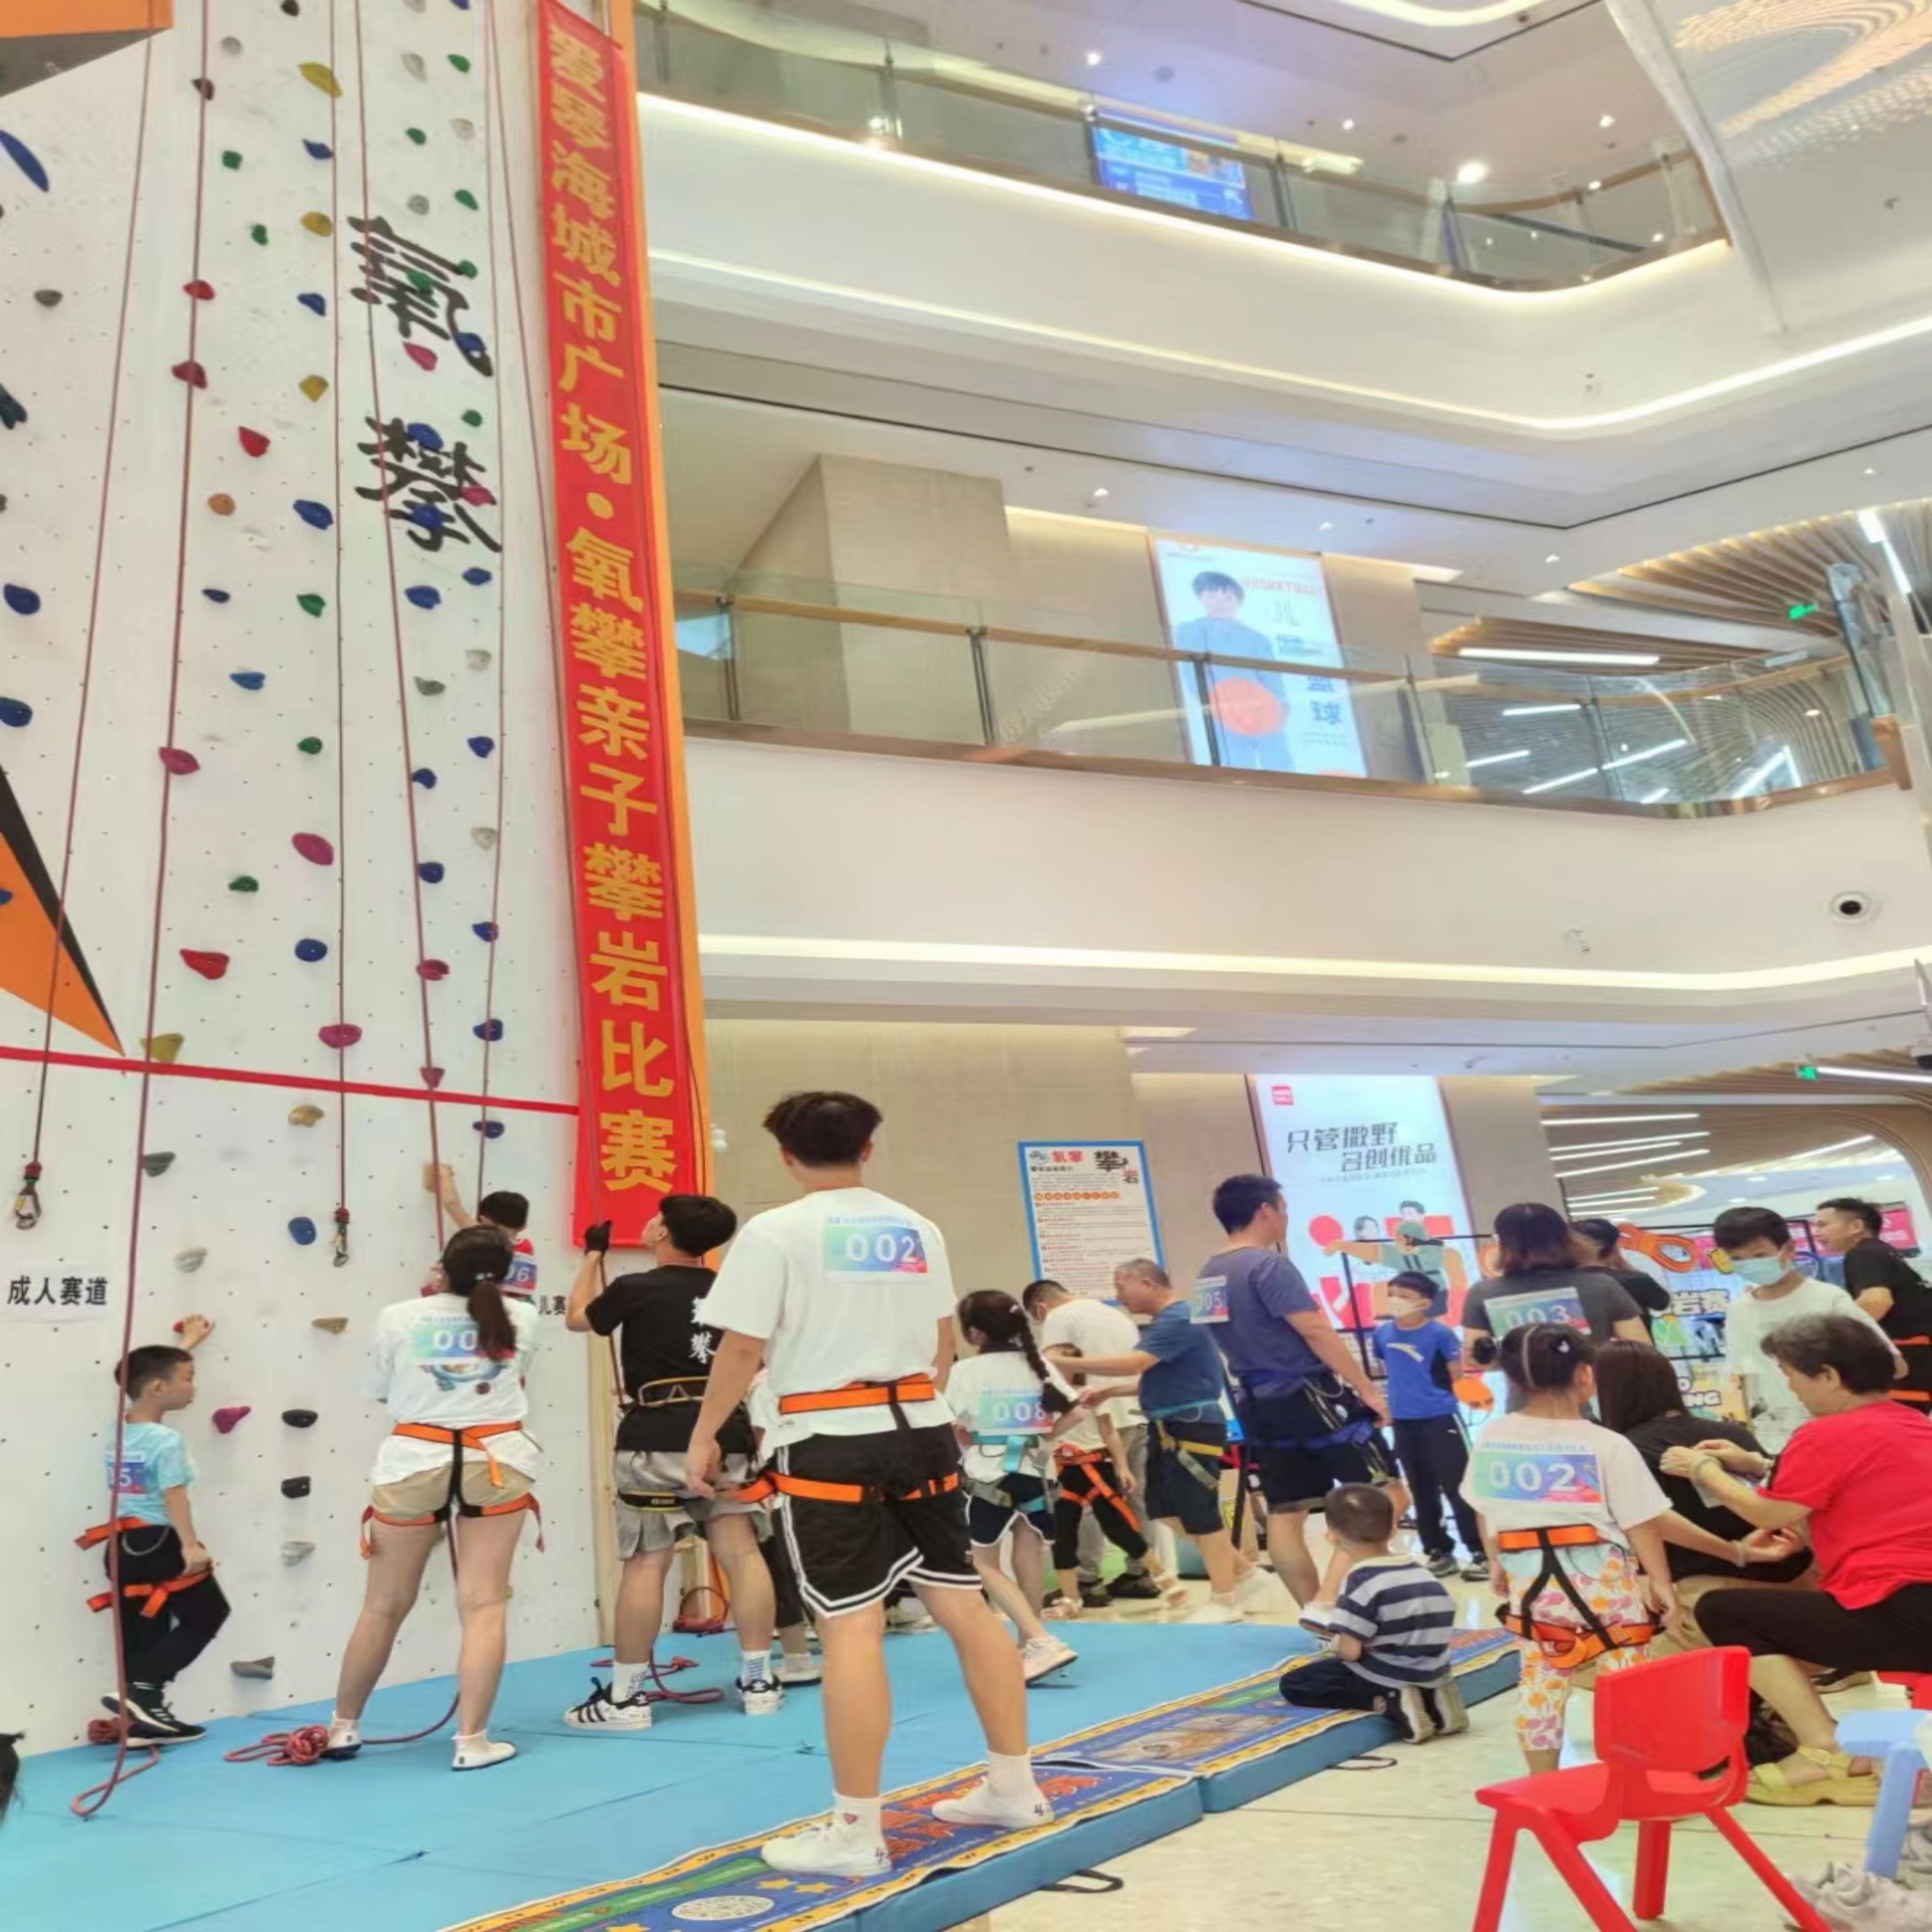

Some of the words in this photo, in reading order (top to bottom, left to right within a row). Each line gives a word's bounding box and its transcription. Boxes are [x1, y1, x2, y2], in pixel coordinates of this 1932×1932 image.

[847, 1234, 918, 1263] 002
[6, 1275, 108, 1306] 成人赛道
[538, 1294, 566, 1315] 儿赛
[433, 1330, 480, 1352] 00
[1491, 1460, 1577, 1492] 002
